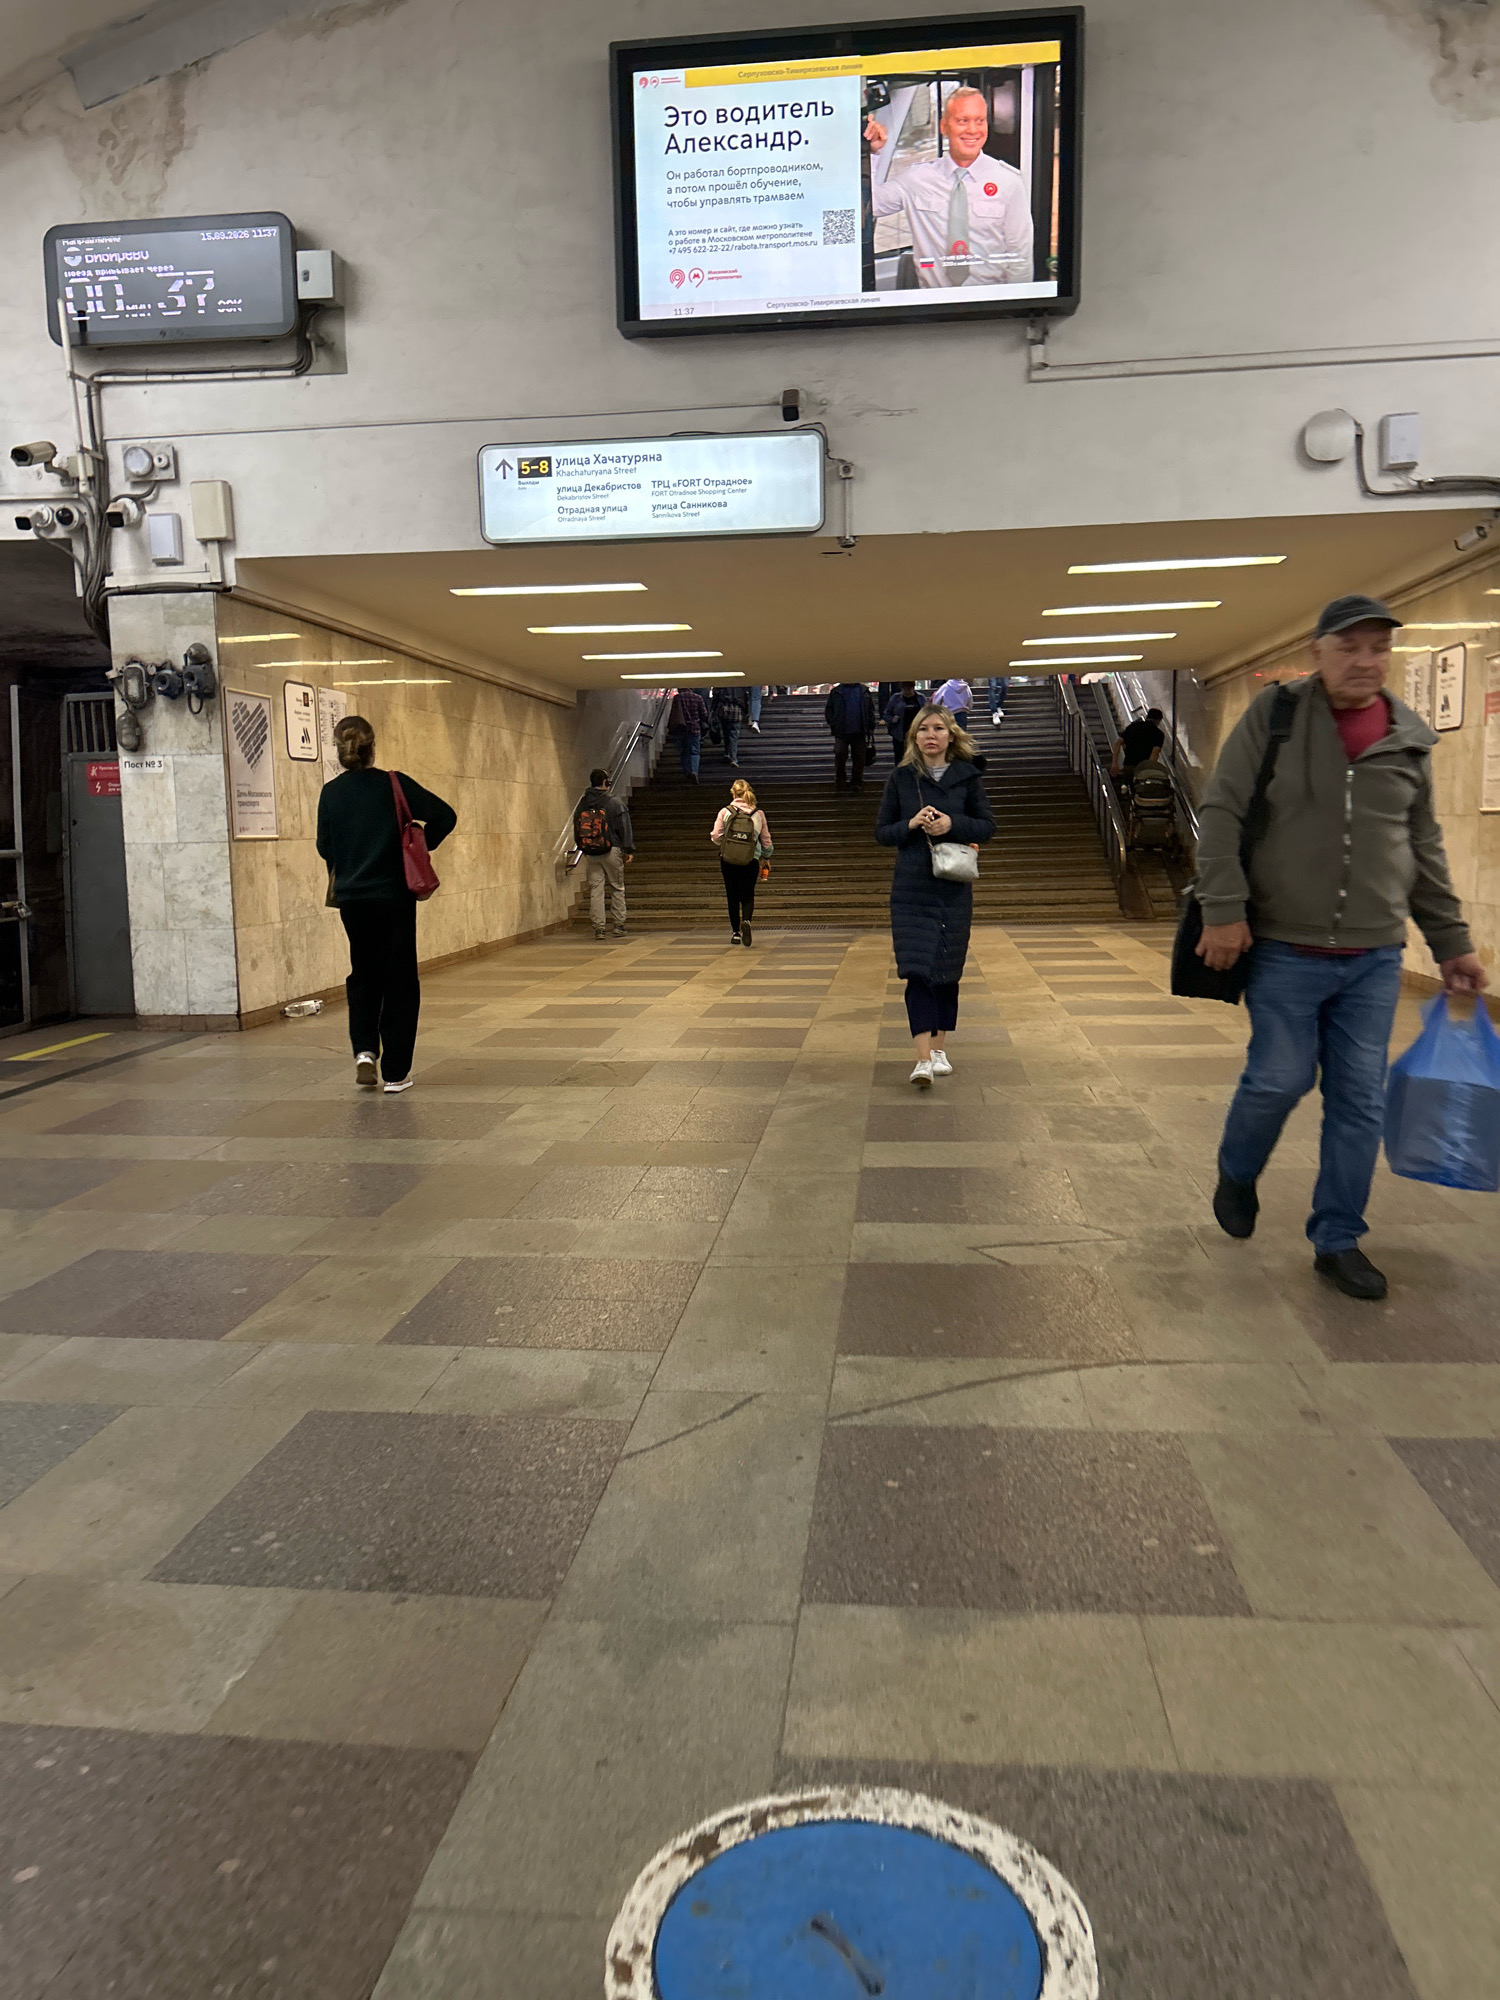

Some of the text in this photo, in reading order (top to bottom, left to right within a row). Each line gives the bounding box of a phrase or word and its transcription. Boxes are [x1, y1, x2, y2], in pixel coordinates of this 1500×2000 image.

[664, 101, 834, 128] Это водитель
[664, 129, 809, 155] Александр.
[666, 162, 824, 182] Он работал бортпроводником,
[666, 178, 802, 195] а потом прошёл обучение,
[666, 191, 805, 209] чтобы управлять трамваем
[252, 228, 277, 238] 11:37
[668, 229, 674, 237] А
[688, 227, 712, 238] номер
[720, 224, 738, 234] сайт,
[739, 225, 751, 234] где
[752, 223, 778, 231] можно
[778, 221, 803, 231] узнать
[674, 236, 700, 247] работе
[708, 233, 755, 244] Московском
[756, 230, 813, 242] метрополитене
[677, 246, 692, 254] 495
[147, 264, 175, 273] через
[555, 453, 662, 469] улица Хачатуряна
[556, 466, 637, 478] Khachaturyana Street
[556, 482, 642, 495] улица Декабристов
[651, 479, 671, 489] ТРЦ
[703, 477, 753, 488] Отрадное»
[698, 487, 726, 496] Shopping
[557, 504, 628, 516] Отрадная улица
[651, 500, 728, 513] улица Санникова
[123, 760, 144, 769] Пост
[145, 760, 156, 768] №
[157, 760, 163, 768] 3
